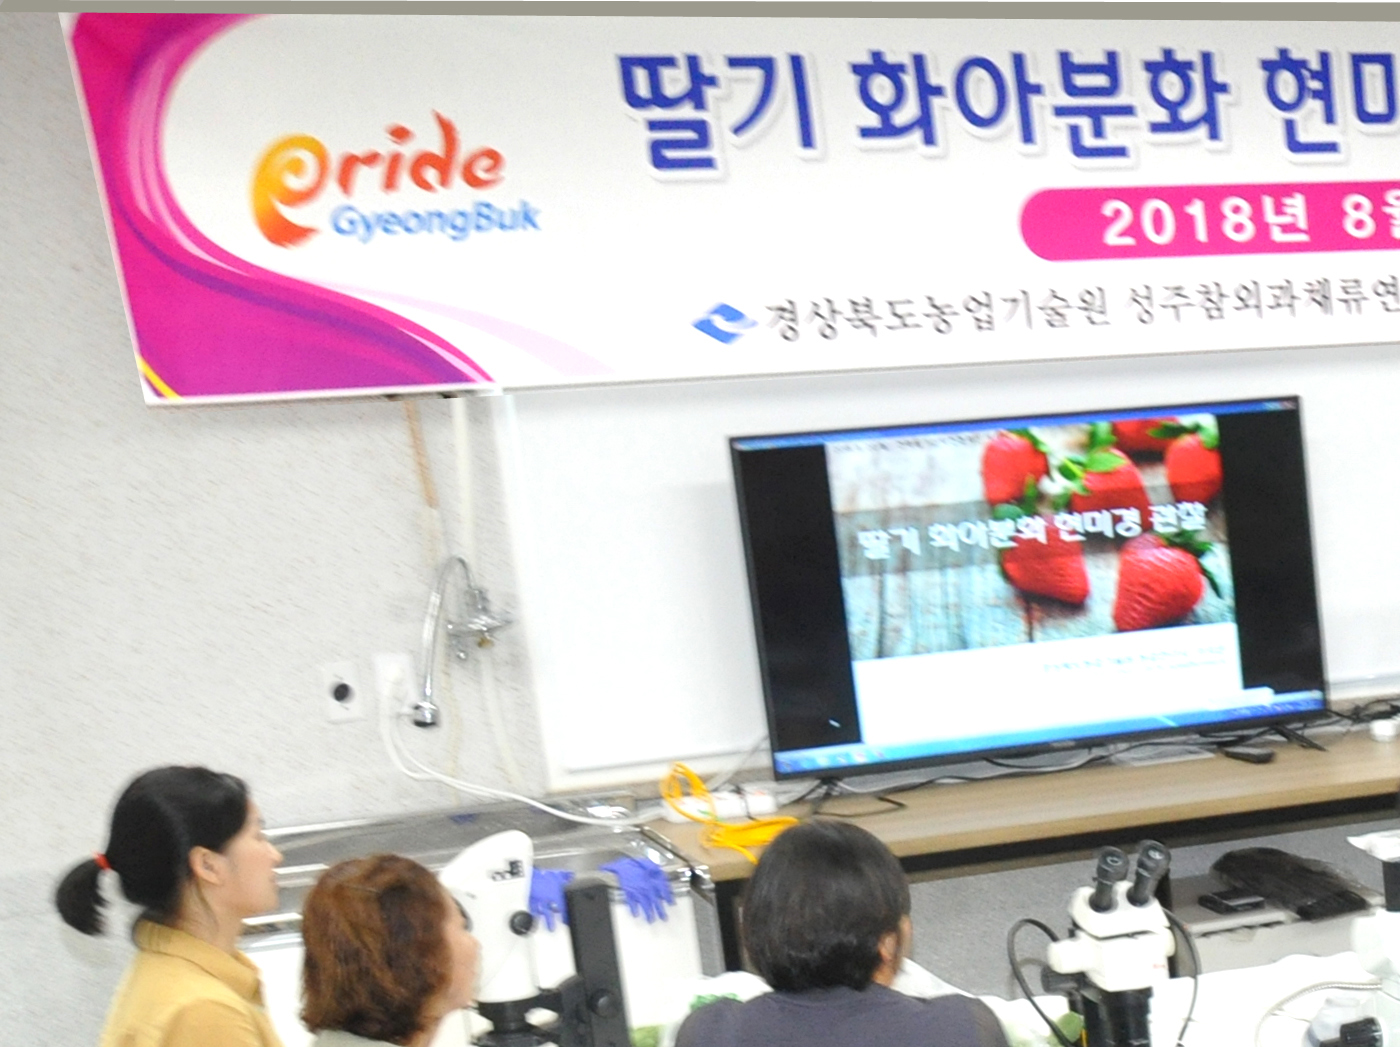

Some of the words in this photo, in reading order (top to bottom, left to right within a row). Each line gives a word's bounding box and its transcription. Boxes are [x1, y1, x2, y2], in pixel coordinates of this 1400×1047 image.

[617, 52, 814, 170] 딸기
[849, 48, 1232, 157] 화아분화
[329, 198, 542, 245] GyeongBuk
[1101, 193, 1310, 246] 2018년
[763, 285, 1112, 343] 경상북도농업기술원
[858, 525, 922, 560] 딸기
[928, 514, 1048, 552] 화아분화
[1052, 506, 1144, 542] 현미경
